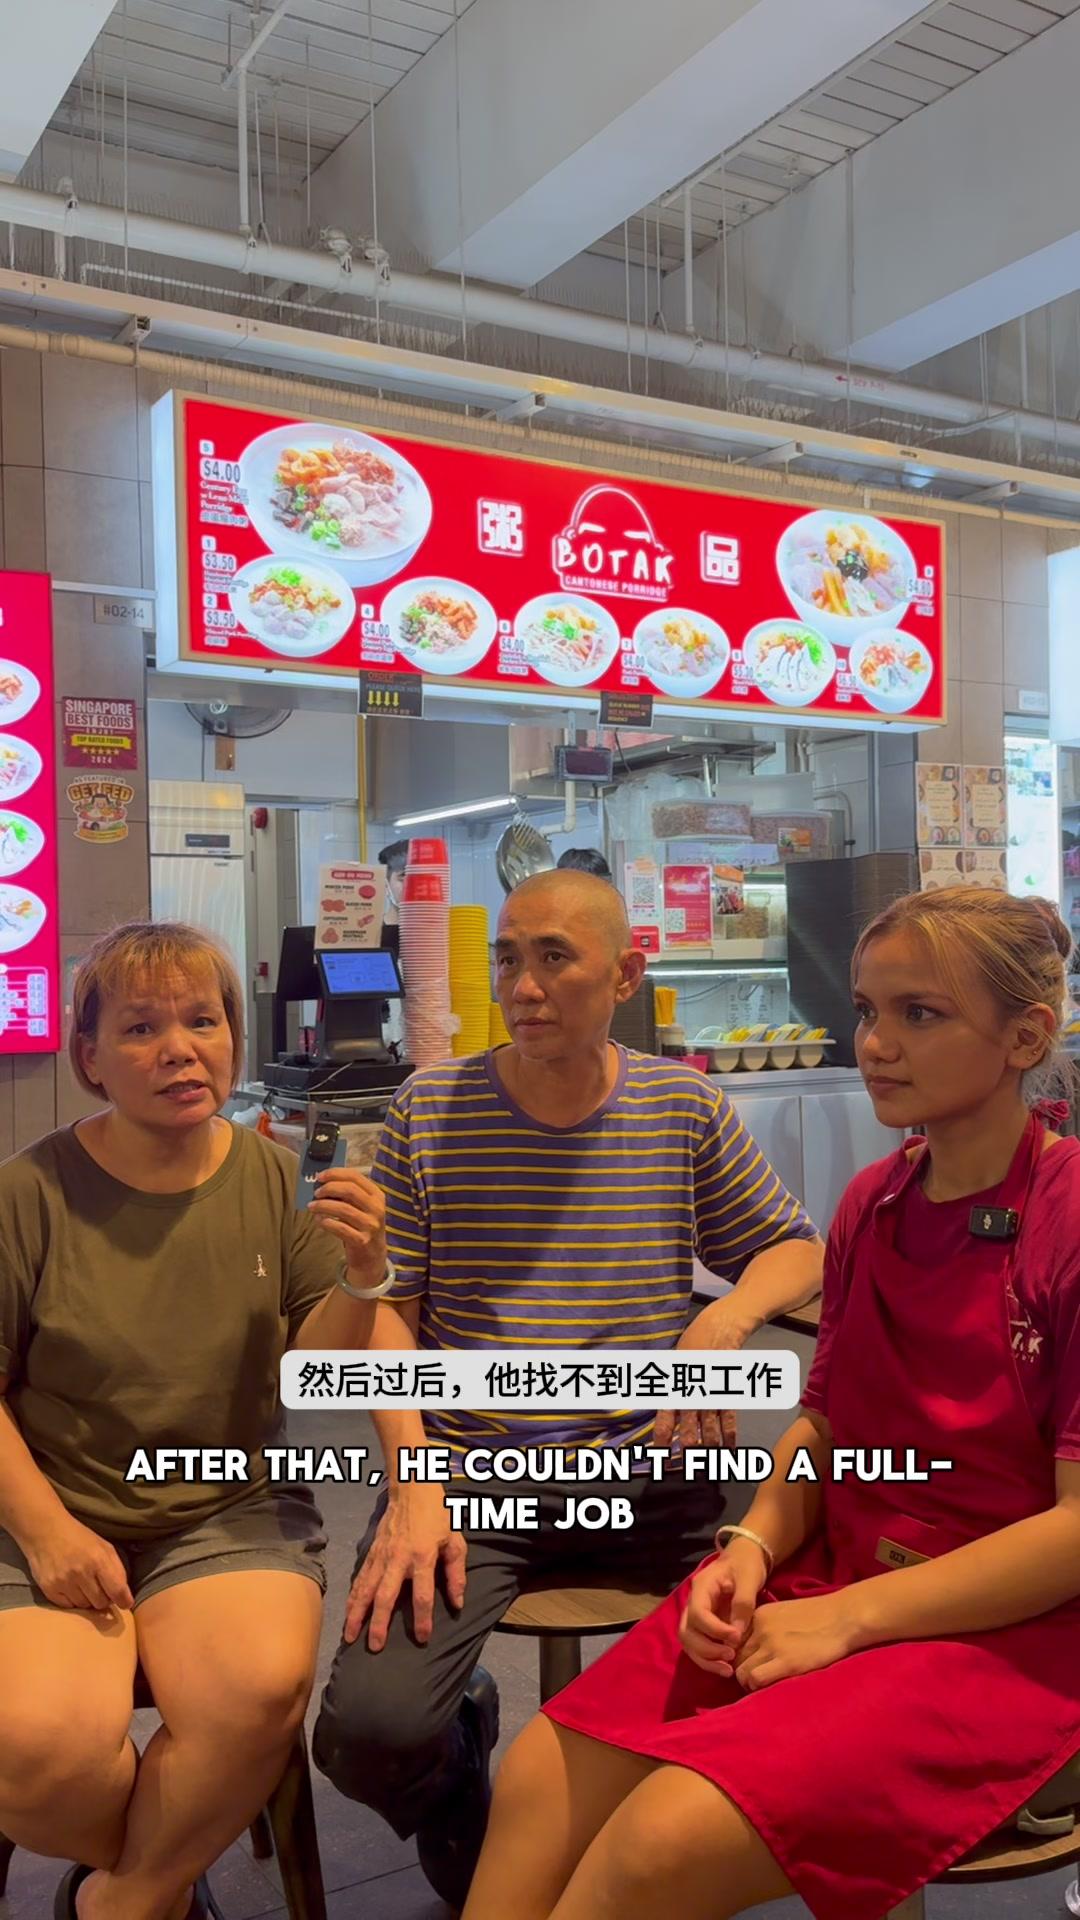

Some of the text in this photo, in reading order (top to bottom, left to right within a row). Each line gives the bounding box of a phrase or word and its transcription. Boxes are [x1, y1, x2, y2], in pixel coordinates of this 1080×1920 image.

[203, 460, 241, 483] $4.00
[205, 553, 235, 570] $3.50
[557, 537, 674, 584] BOTAK
[705, 534, 740, 580] 品
[565, 575, 667, 598] CANTONESE PORRIDGE
[103, 603, 145, 620] #02-14
[206, 610, 236, 628] $3.50
[364, 622, 390, 637] $4.00
[65, 699, 133, 716] SINGAPORE
[67, 713, 131, 728] BEST FOODS
[69, 783, 131, 801] GET FED
